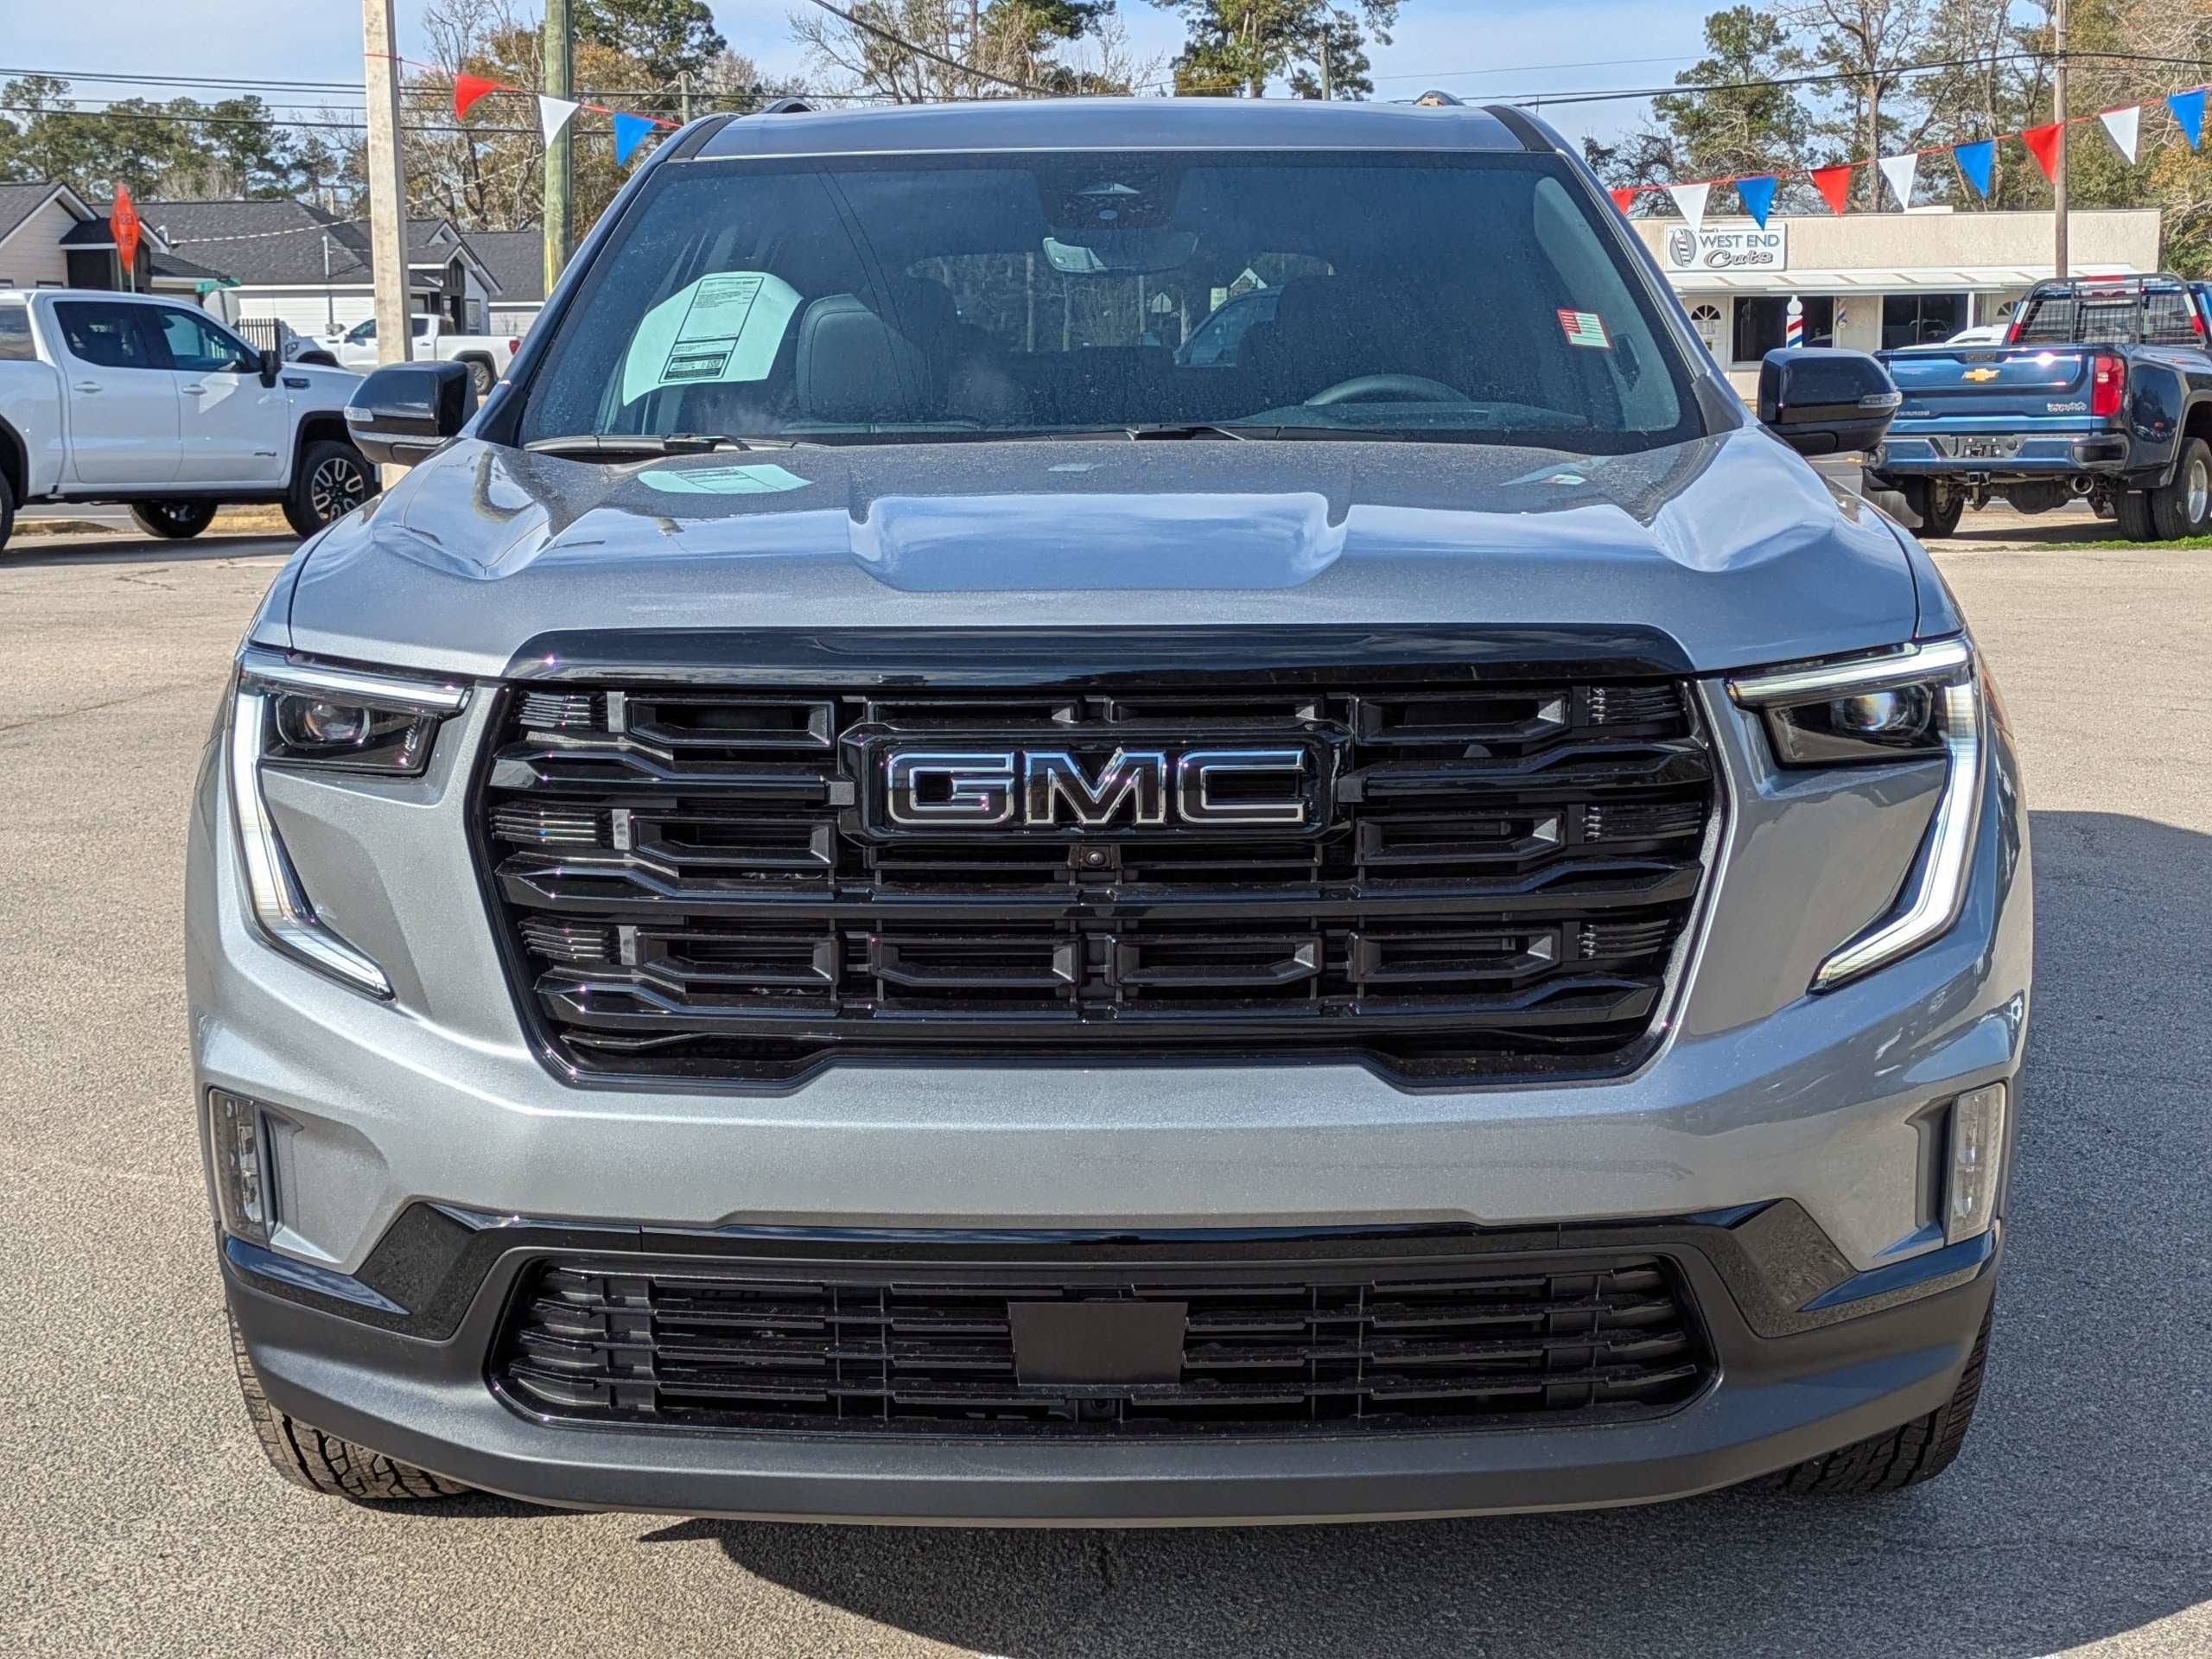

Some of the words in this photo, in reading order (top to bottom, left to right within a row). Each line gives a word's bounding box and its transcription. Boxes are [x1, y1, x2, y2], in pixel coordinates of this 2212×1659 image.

[1700, 234, 1743, 248] WEST
[1746, 234, 1780, 248] END
[1704, 249, 1773, 269] Cuts
[887, 748, 1305, 826] GMC
